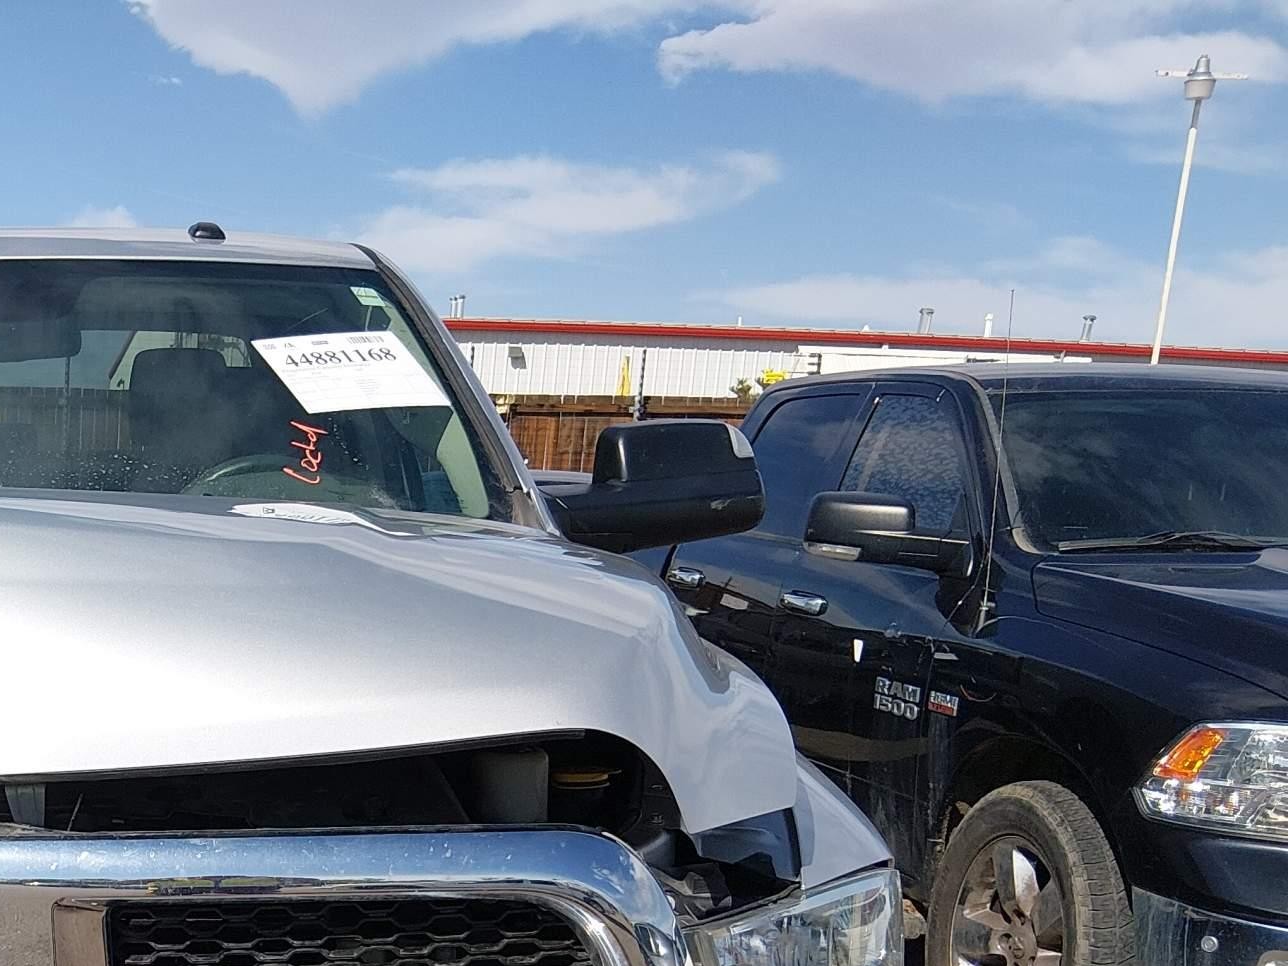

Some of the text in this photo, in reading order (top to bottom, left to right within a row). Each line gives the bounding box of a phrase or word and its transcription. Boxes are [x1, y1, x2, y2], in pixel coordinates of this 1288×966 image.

[285, 347, 397, 368] 44881168
[874, 676, 921, 703] RAM
[873, 693, 919, 721] 1500
